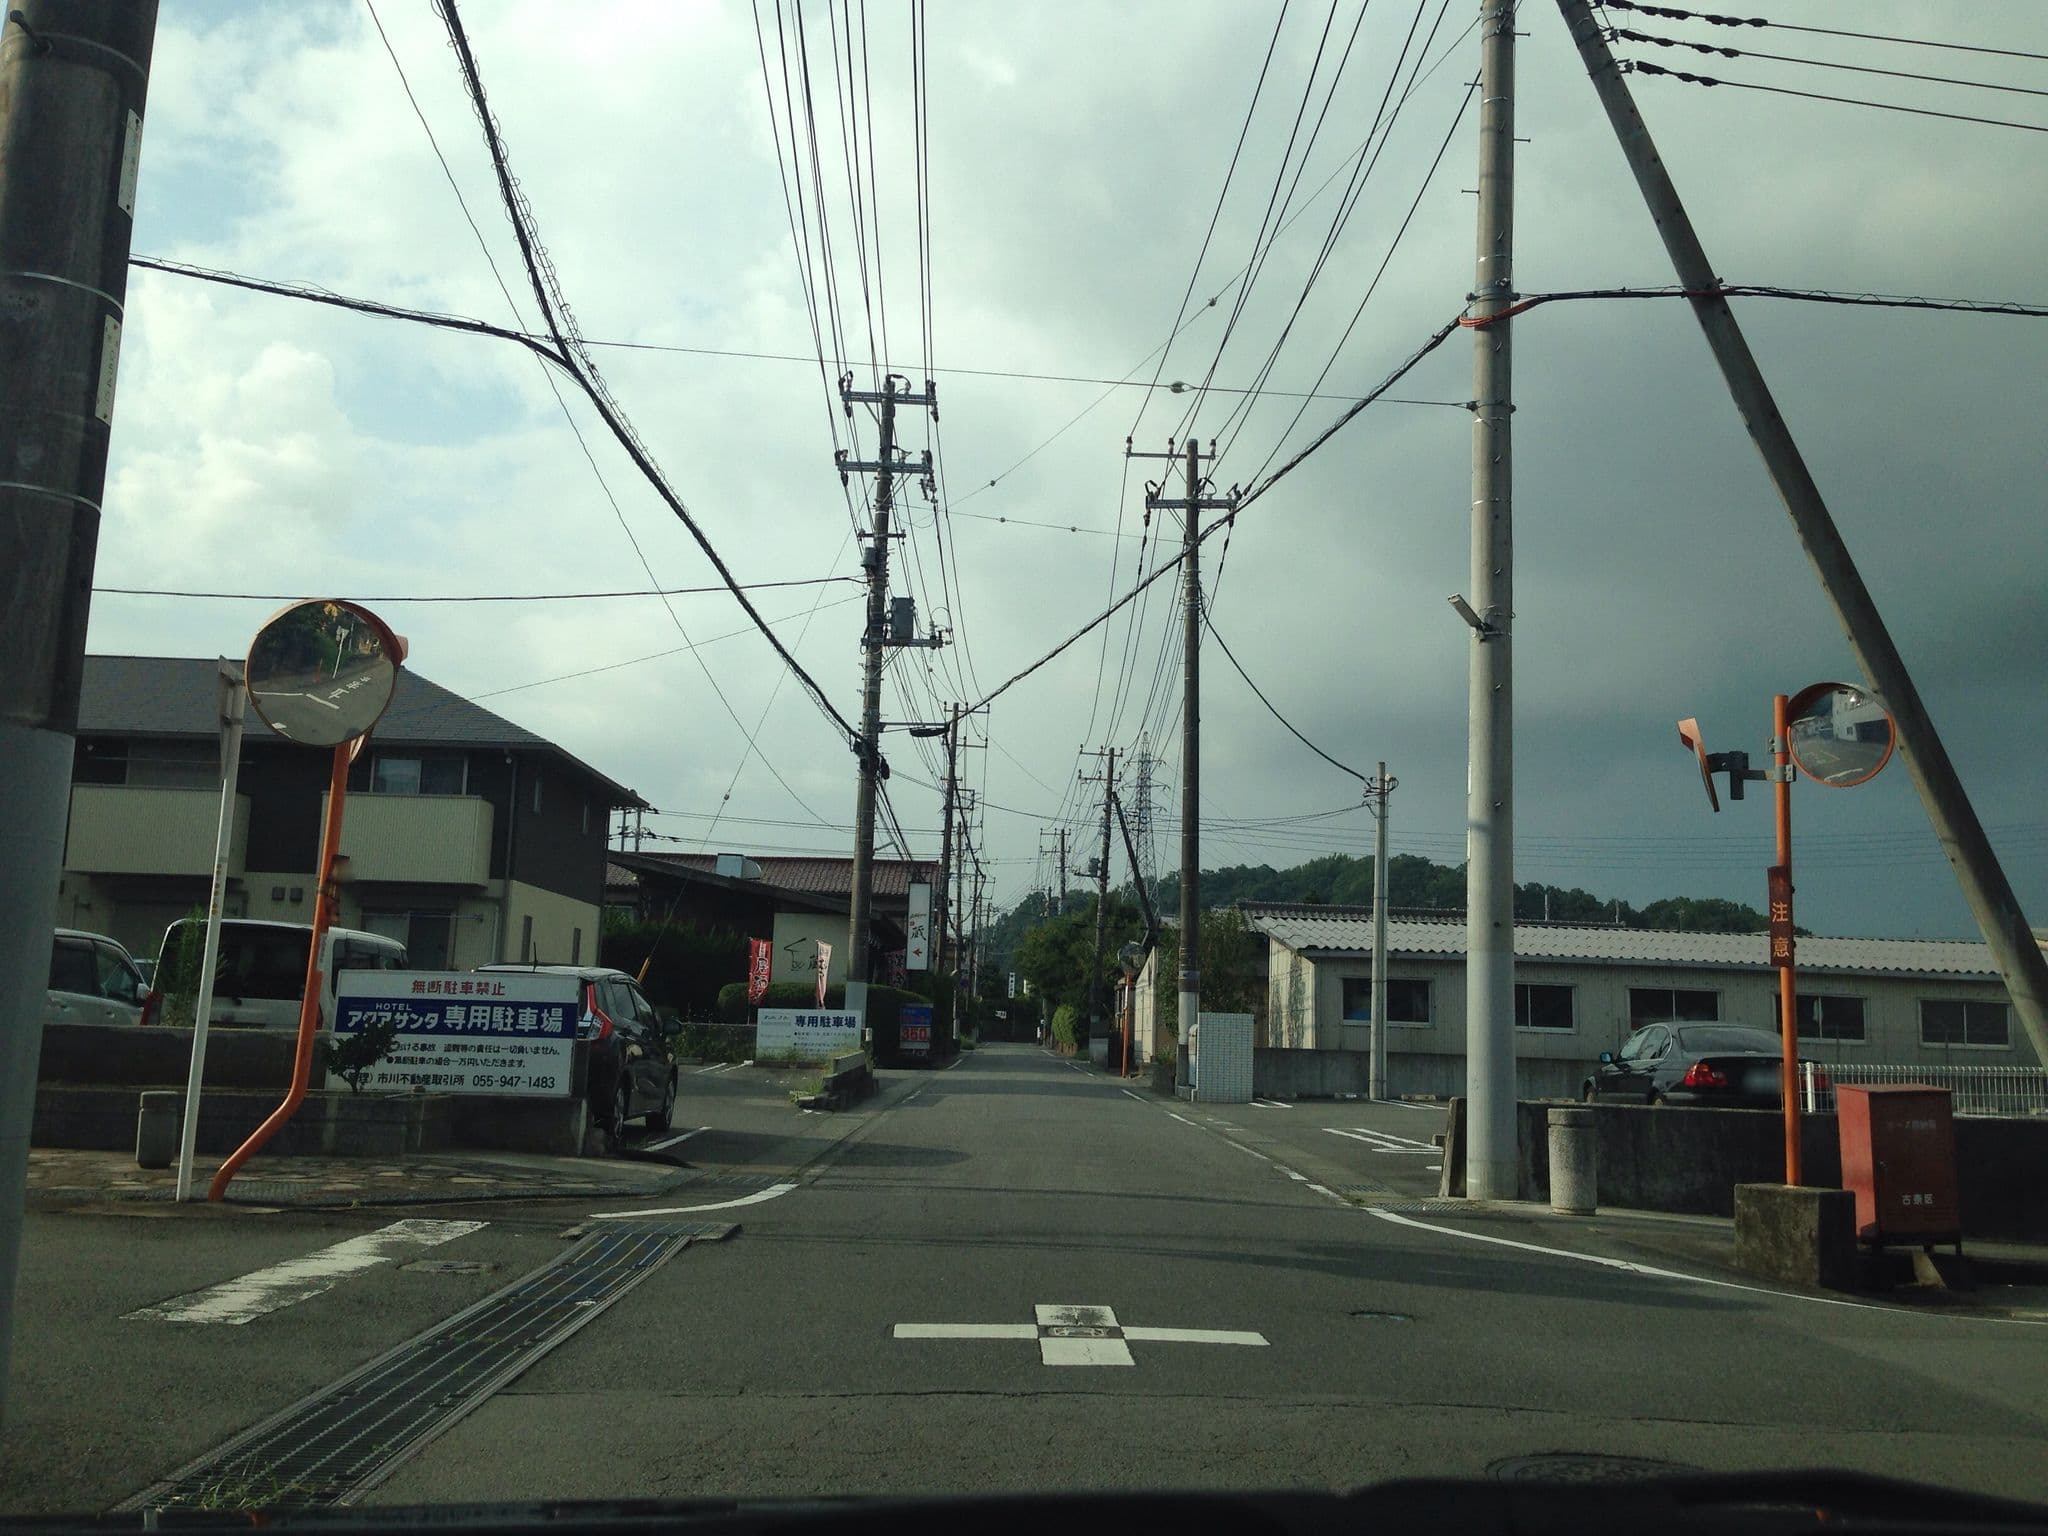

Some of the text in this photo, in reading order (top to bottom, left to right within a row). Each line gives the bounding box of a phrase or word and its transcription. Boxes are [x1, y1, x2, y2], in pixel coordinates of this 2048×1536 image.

[1772, 900, 1789, 957] 注意
[411, 980, 505, 996] 無断駐車禁止
[375, 1002, 412, 1011] HOTEL
[347, 1005, 563, 1033] アクアサンタ 専用駐車場
[795, 1015, 857, 1029] 専用駐車場
[377, 1072, 464, 1087] 市川不動産取引所
[473, 1074, 555, 1089] 055-947-1483
